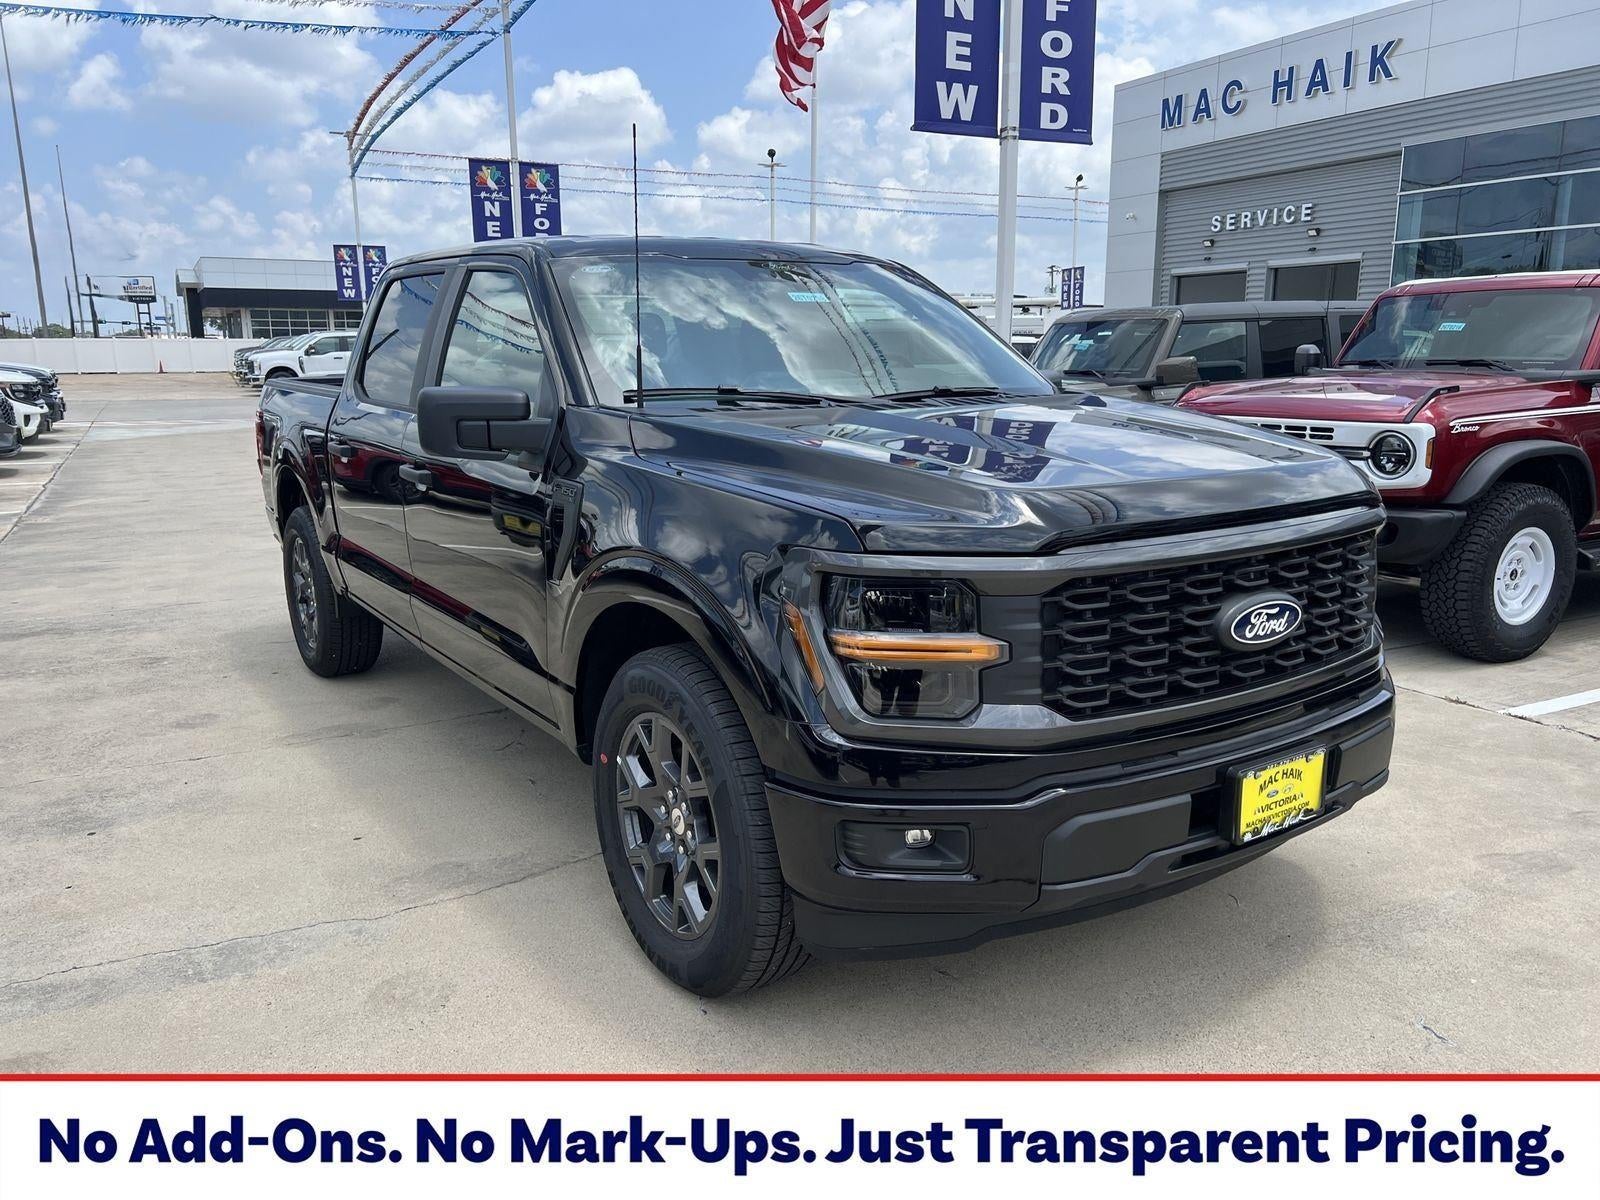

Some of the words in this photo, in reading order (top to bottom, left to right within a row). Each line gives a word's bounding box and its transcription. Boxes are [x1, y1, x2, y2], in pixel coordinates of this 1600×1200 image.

[1040, 0, 1073, 130] FORD
[1160, 79, 1246, 131] MAC
[1271, 38, 1402, 105] HAIK
[1210, 203, 1313, 232] SERVICE
[342, 266, 356, 298] NEW
[1450, 424, 1481, 434] Bronco
[1245, 606, 1290, 639] Ford
[1258, 771, 1280, 796] MAC
[1281, 767, 1303, 782] HAIK
[1260, 794, 1298, 813] VICTORIA
